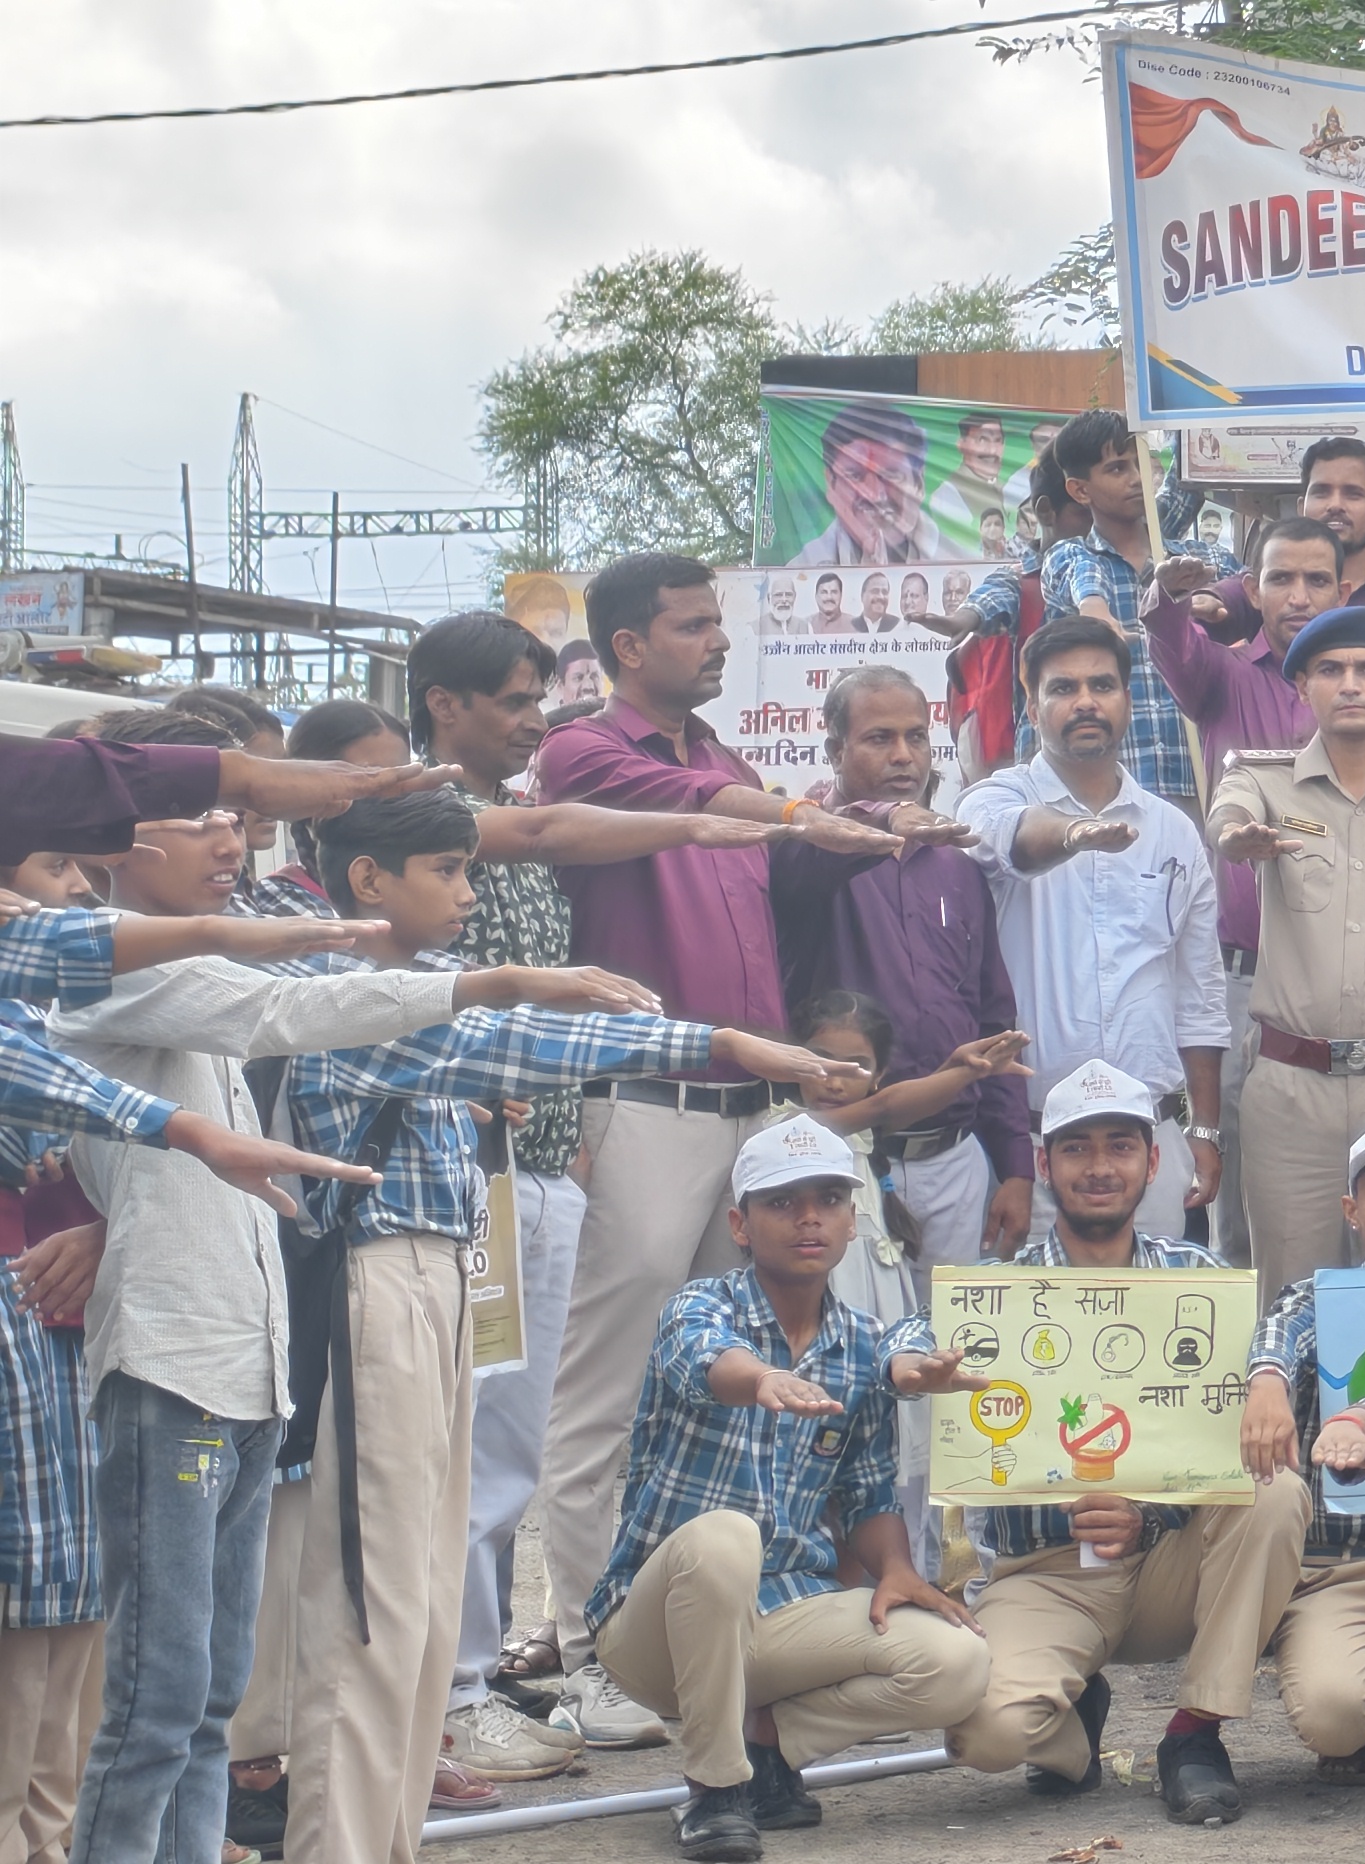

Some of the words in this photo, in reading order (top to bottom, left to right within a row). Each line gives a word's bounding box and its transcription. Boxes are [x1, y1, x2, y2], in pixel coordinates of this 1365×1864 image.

[1169, 64, 1202, 79] Code
[739, 701, 813, 736] अनिल
[731, 738, 819, 766] न्मदिन
[950, 1285, 1012, 1315] नशा
[1029, 1280, 1060, 1319] है
[979, 1396, 1025, 1418] STOP
[1138, 1384, 1190, 1407] नशा
